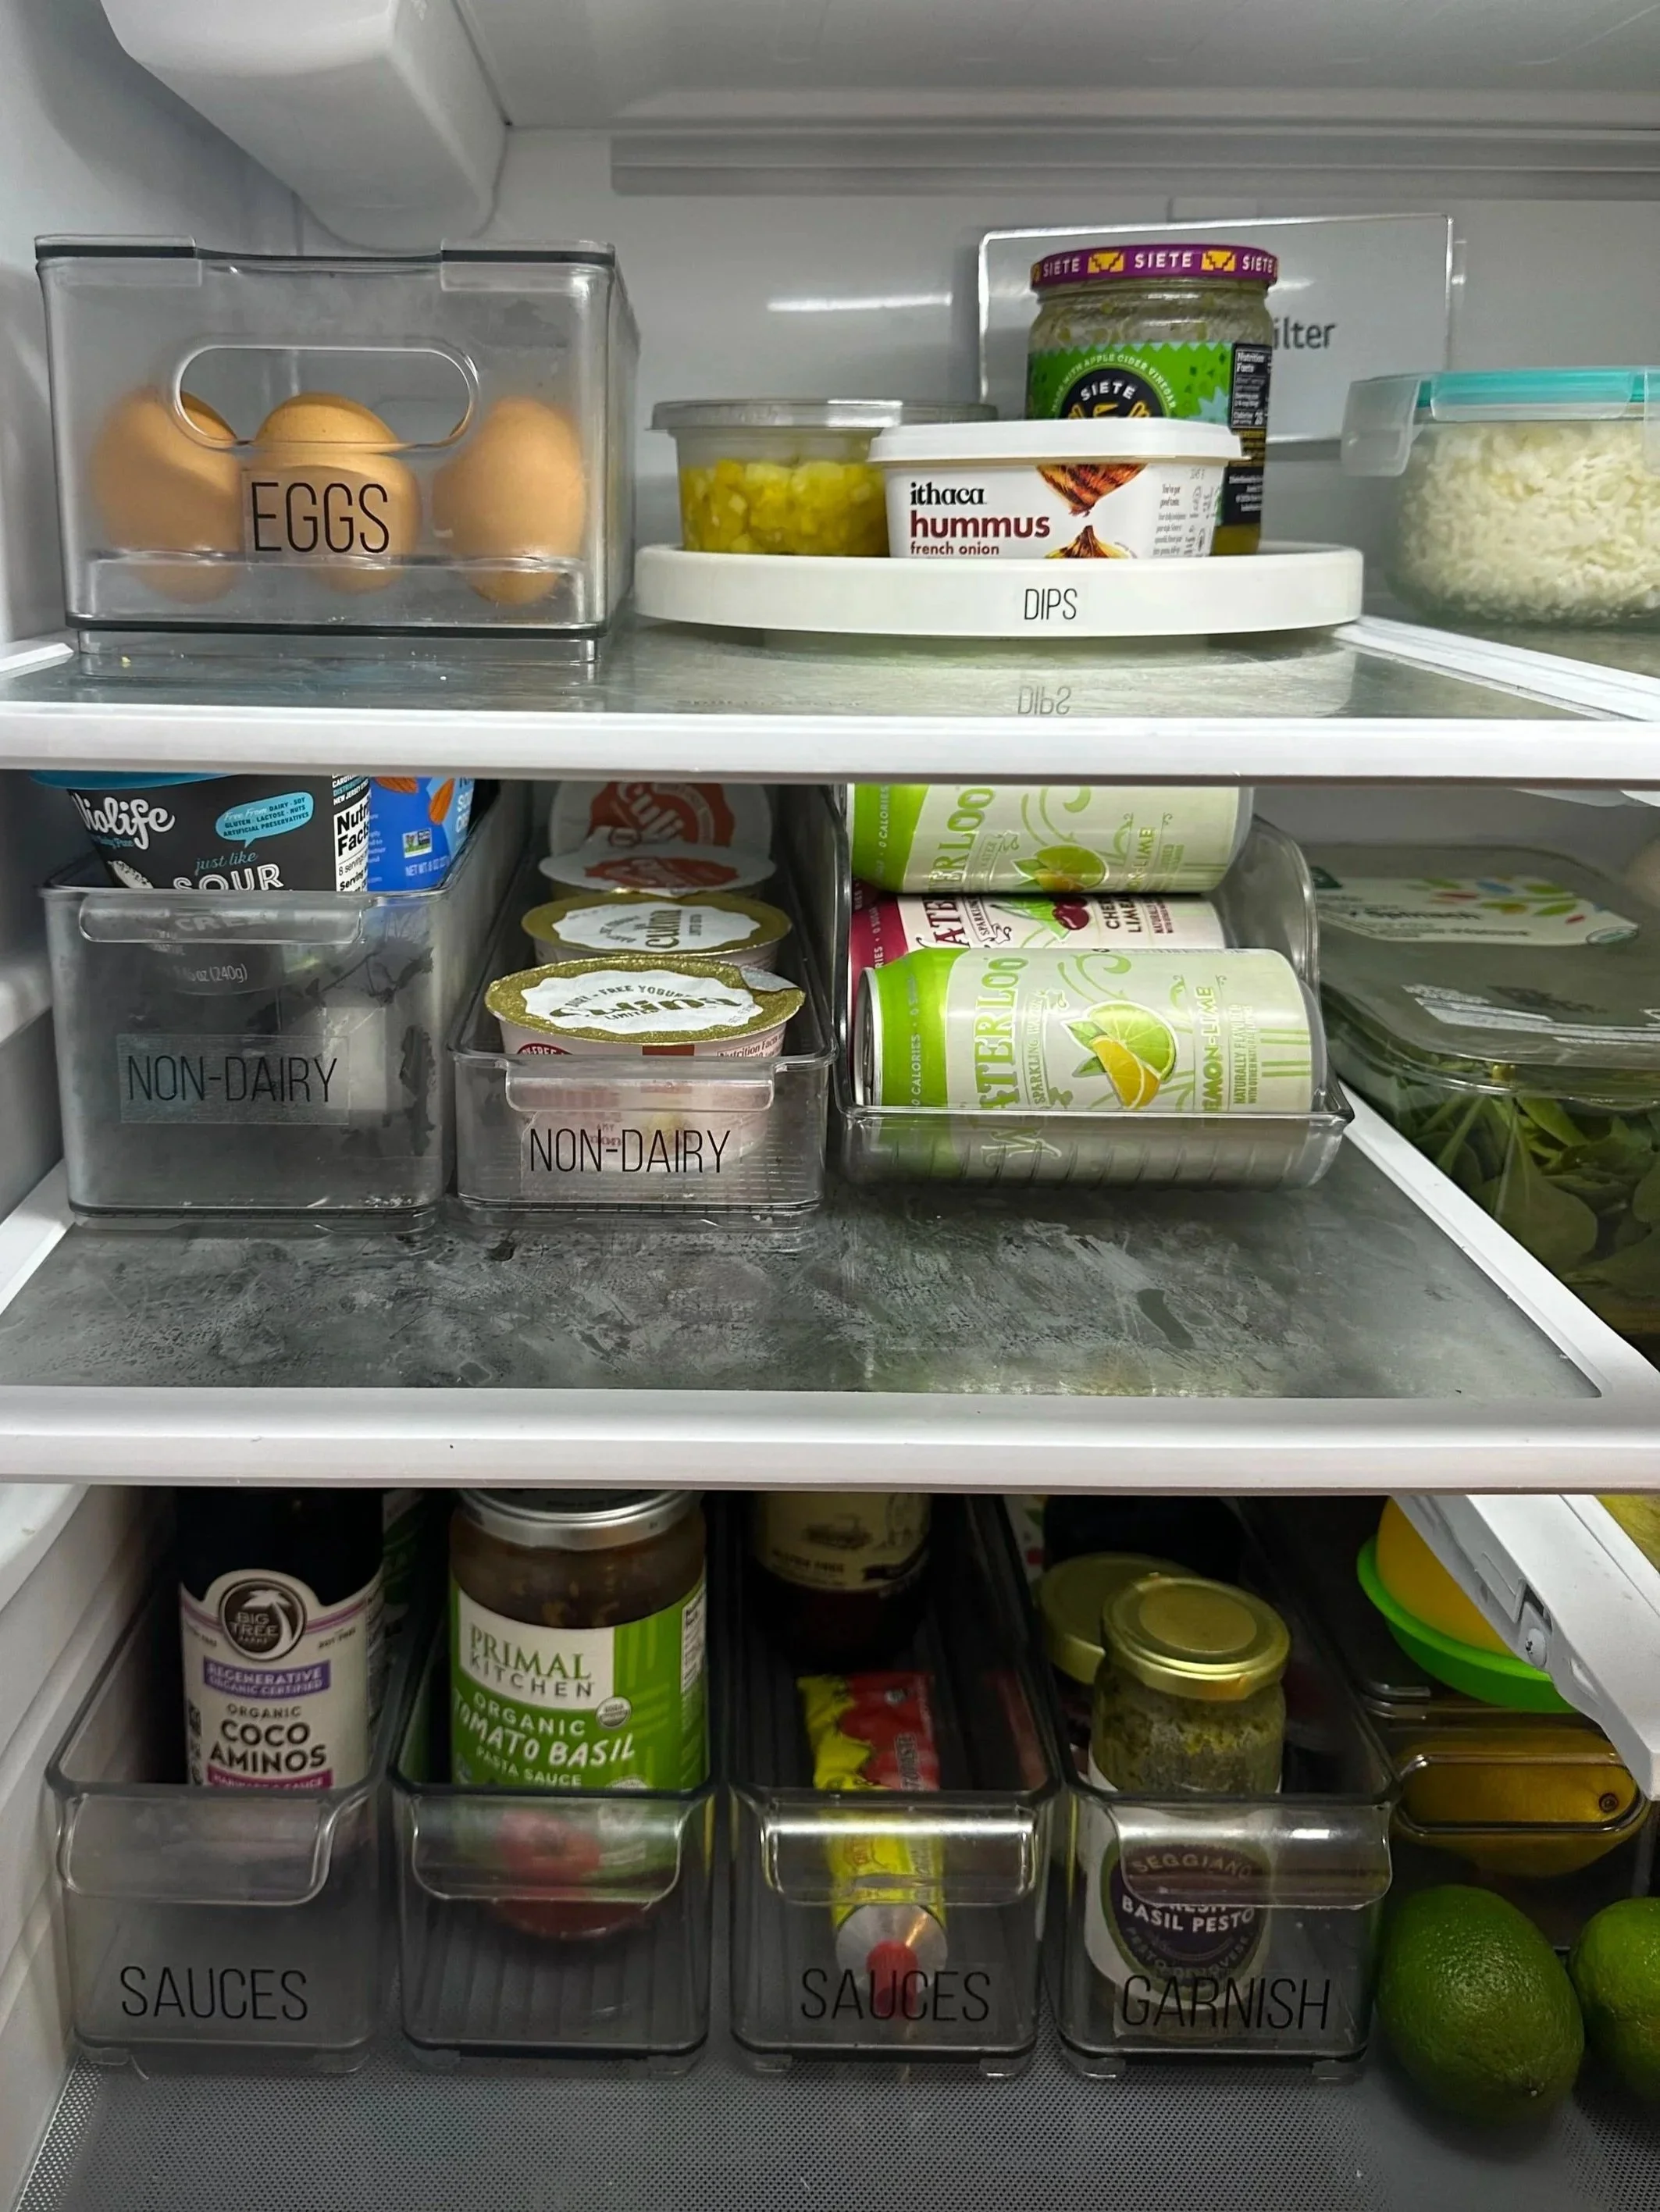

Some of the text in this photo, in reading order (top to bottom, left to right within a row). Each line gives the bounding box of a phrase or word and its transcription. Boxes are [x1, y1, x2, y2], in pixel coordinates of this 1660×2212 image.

[1043, 251, 1273, 277] SIETE SIETE SIETE
[1273, 316, 1338, 350] ilter
[1081, 381, 1136, 401] SIETE
[1085, 353, 1115, 367] APPLE
[1117, 354, 1148, 371] CIDER
[1149, 367, 1177, 409] VINEGAR
[910, 482, 985, 506] ithaca
[250, 481, 390, 553] EGGS
[910, 510, 1050, 538] hummus
[910, 541, 999, 555] french onion
[1024, 588, 1078, 621] DIPS
[225, 819, 251, 828] GLUTEN
[256, 812, 285, 822] LACTOSE
[269, 802, 288, 812] DAIRY
[878, 785, 890, 839] CALORIES
[223, 812, 309, 837] ARTIFICIAL PRESERVATIVES
[194, 850, 258, 875] just like
[338, 866, 344, 876] 8
[173, 864, 284, 891] SOUR
[874, 945, 884, 969] RIES
[209, 964, 248, 983] (240g)
[1195, 986, 1224, 1113] EMON-LIME
[127, 1055, 337, 1102] NON-DAIRY
[911, 1034, 921, 1095] CALORIES
[1027, 1040, 1046, 1105] SPARKLING
[1234, 1052, 1247, 1104] NATURALLY
[1248, 1065, 1258, 1085] OTHER
[1248, 1085, 1257, 1104] WITH
[529, 1128, 731, 1174] NON-DAIRY
[230, 1622, 279, 1637] TREE
[237, 1612, 269, 1625] BIG
[470, 1622, 591, 1680] PRIMAL
[207, 1664, 322, 1686] REGENERATIVE
[209, 1676, 322, 1696] ORGANIC CERTIFIED
[471, 1651, 592, 1697] KITCHEN
[227, 1703, 301, 1719] ORGANIC
[473, 1692, 585, 1736] ORGANIC
[222, 1719, 311, 1747] COCO
[210, 1741, 326, 1773] AMINOS
[549, 1733, 636, 1769] BASIL
[476, 1745, 582, 1786] PASTA SAUCE
[1132, 1854, 1252, 1879] SEGGIANO
[1122, 1895, 1255, 1933] BASIL PESTO
[120, 1965, 308, 2021] SAUCES
[800, 1968, 991, 2022] SAUCES
[1122, 1975, 1330, 2030] GARNISH
